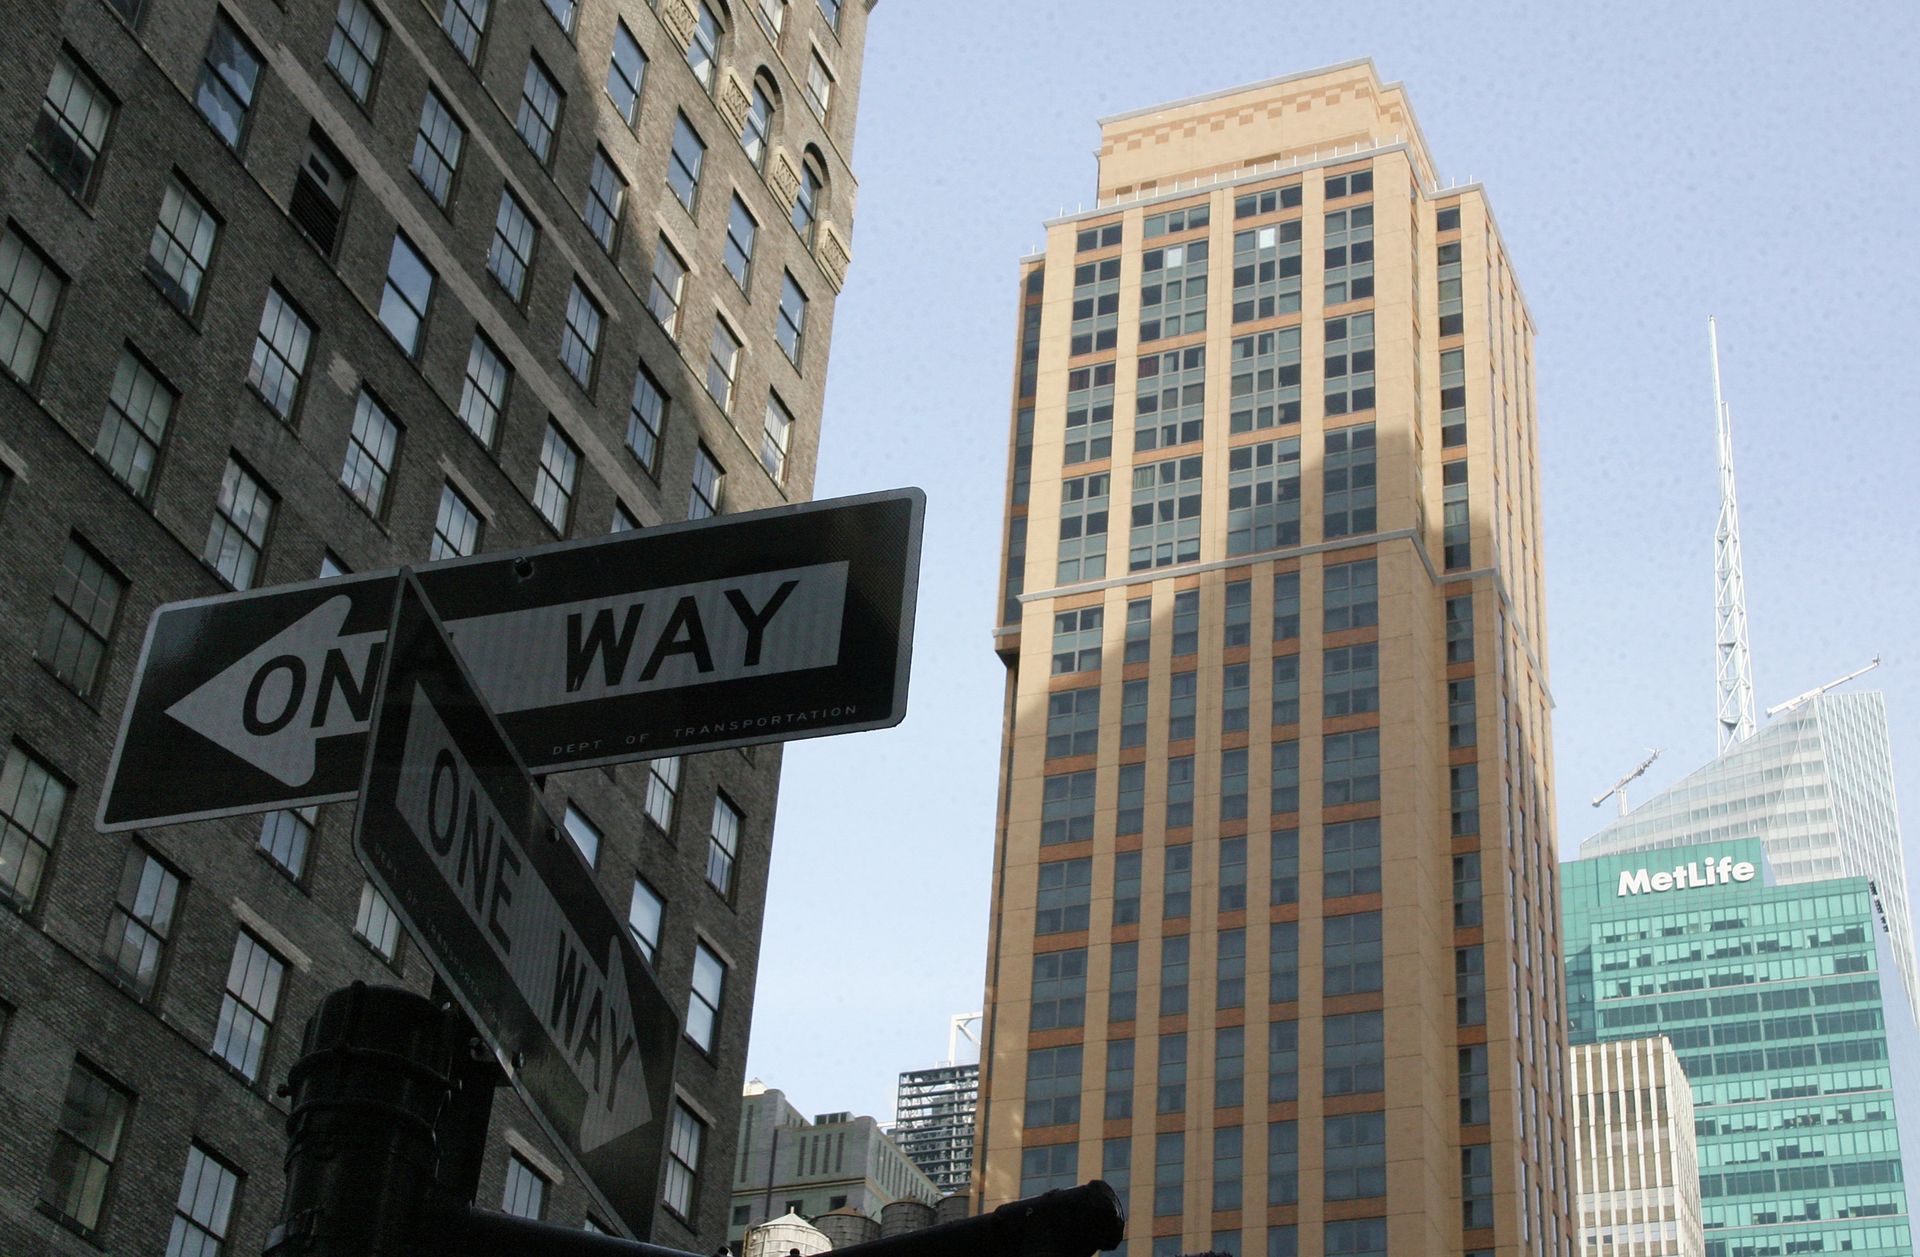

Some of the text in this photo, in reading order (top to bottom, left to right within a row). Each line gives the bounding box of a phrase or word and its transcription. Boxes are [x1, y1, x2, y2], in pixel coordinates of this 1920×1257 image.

[243, 581, 799, 736] ON WAY
[553, 705, 857, 755] DEPT OF TRANSPORTATION
[1618, 856, 1755, 897] MetLife
[428, 748, 634, 1112] ONE WAY
